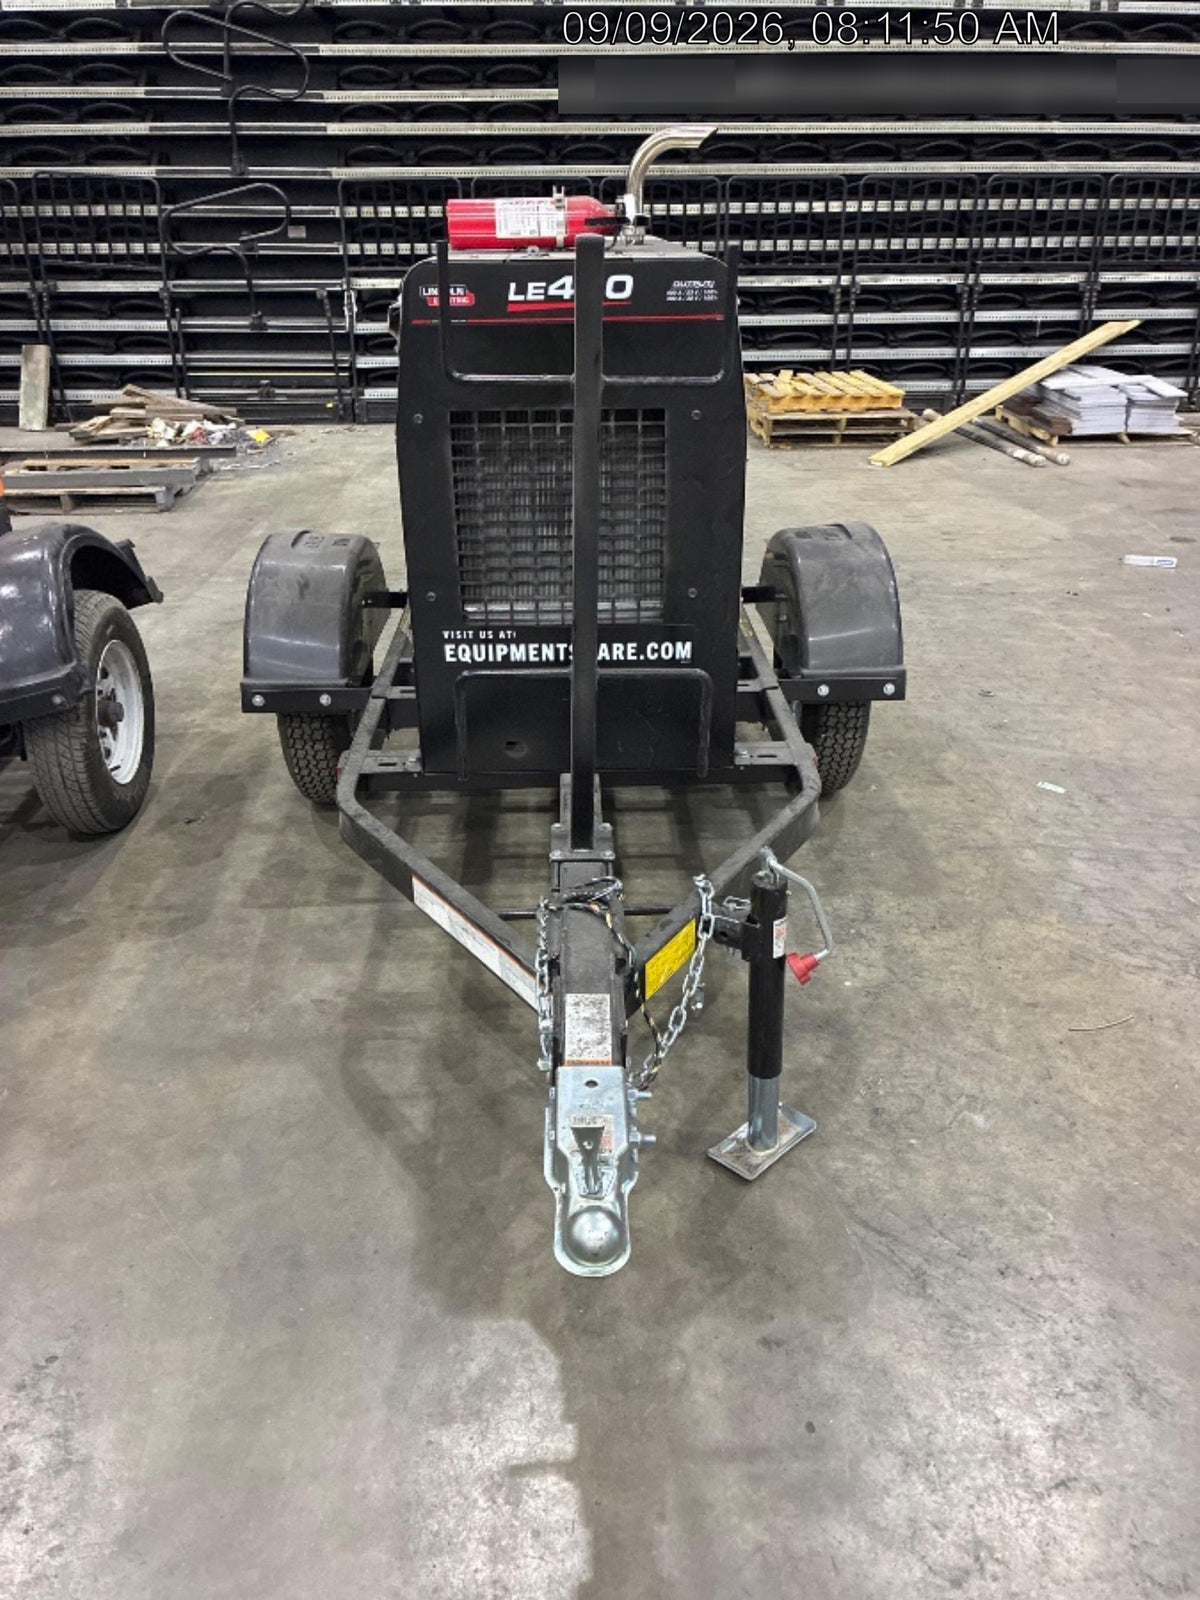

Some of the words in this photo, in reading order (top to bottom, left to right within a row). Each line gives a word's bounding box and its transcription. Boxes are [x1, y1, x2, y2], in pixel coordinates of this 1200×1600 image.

[508, 274, 634, 302] LE40
[442, 630, 474, 640] VISIT
[479, 630, 495, 640] US
[444, 641, 692, 664] EQUIPMENTARE.COM
